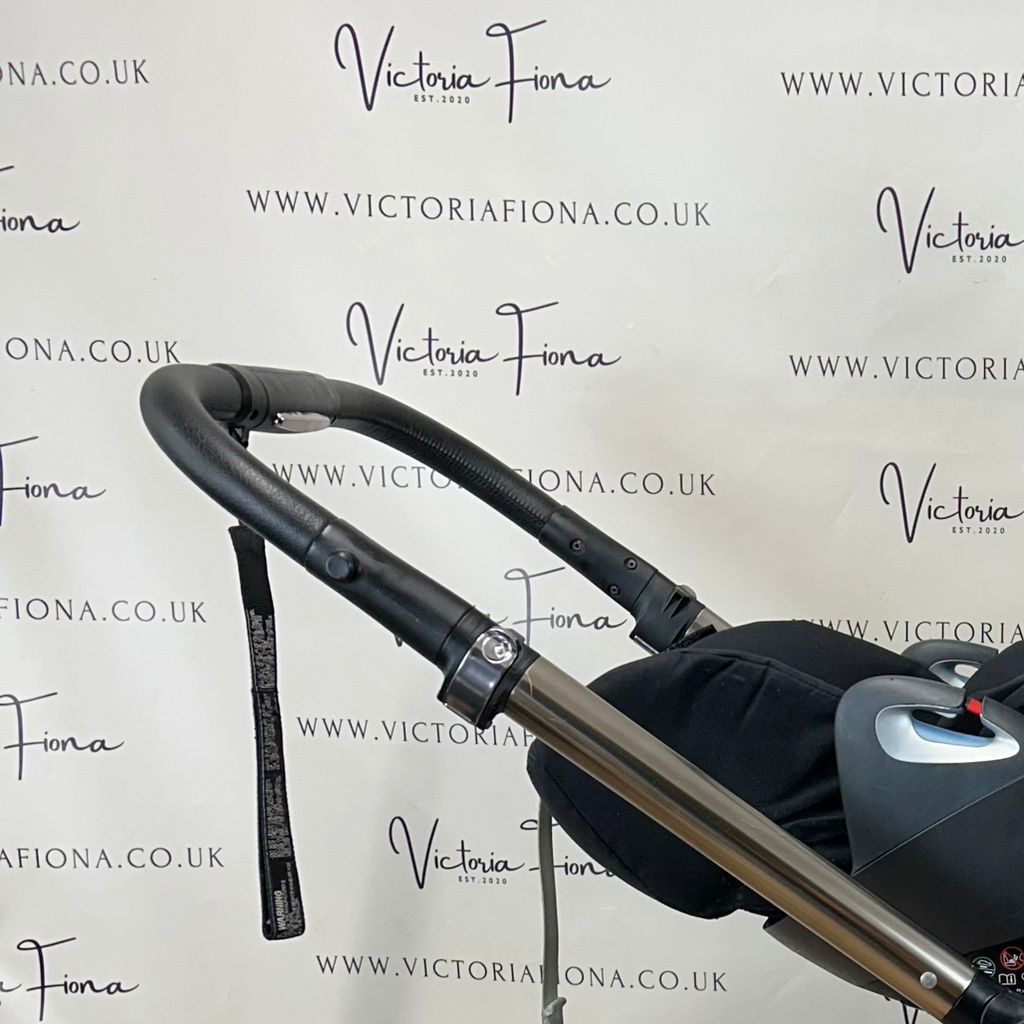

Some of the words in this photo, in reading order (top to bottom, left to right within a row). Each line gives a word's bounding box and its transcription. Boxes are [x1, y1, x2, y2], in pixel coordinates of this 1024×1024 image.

[333, 22, 493, 112] Victoria
[483, 18, 612, 125] Fiona
[413, 93, 471, 105] EST.2020
[245, 189, 711, 227] WWW.VICTORIAFIONA.CO.UK
[951, 254, 1008, 264] EST.2020
[345, 301, 501, 386] Victoria
[491, 300, 623, 397] Fiona
[422, 368, 479, 378] EST.2020
[951, 526, 1006, 535] EST.2020
[388, 815, 529, 890] Victoria
[457, 871, 508, 886] EST.2020
[274, 889, 287, 931] WARNING
[19, 936, 140, 1023] Fiona
